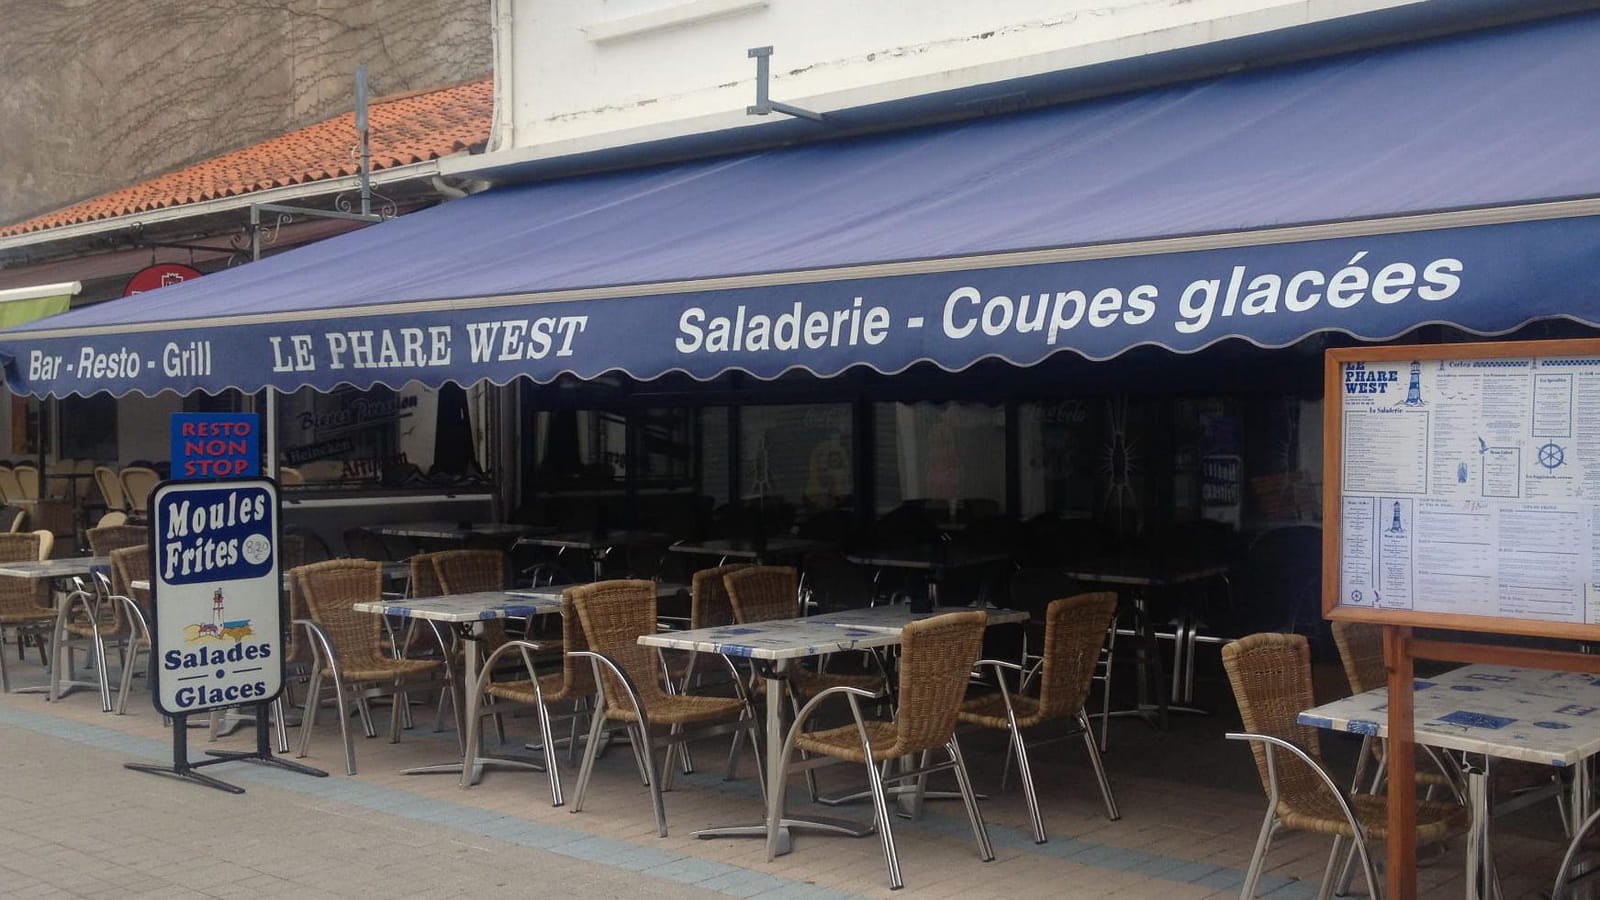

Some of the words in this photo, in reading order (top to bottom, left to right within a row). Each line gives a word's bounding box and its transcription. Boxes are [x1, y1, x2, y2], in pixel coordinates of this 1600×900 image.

[675, 297, 890, 353] Saladerie
[907, 317, 924, 328] -
[943, 286, 1158, 346] Coupes
[1174, 251, 1463, 334] glacées
[269, 335, 316, 372] LE
[325, 326, 451, 369] PHARE
[466, 315, 588, 363] WEST
[29, 350, 62, 381] Bar
[77, 347, 140, 379] Resto
[147, 360, 156, 369] -
[163, 341, 211, 378] Grill
[1345, 371, 1398, 382] PHARE
[1345, 383, 1387, 393] WEST
[182, 422, 250, 436] RESTO
[184, 440, 247, 456] NON
[184, 460, 249, 477] STOP
[167, 492, 265, 539] Moules
[164, 538, 238, 580] Frites
[164, 642, 271, 670] Salades
[175, 680, 266, 709] Glaces
